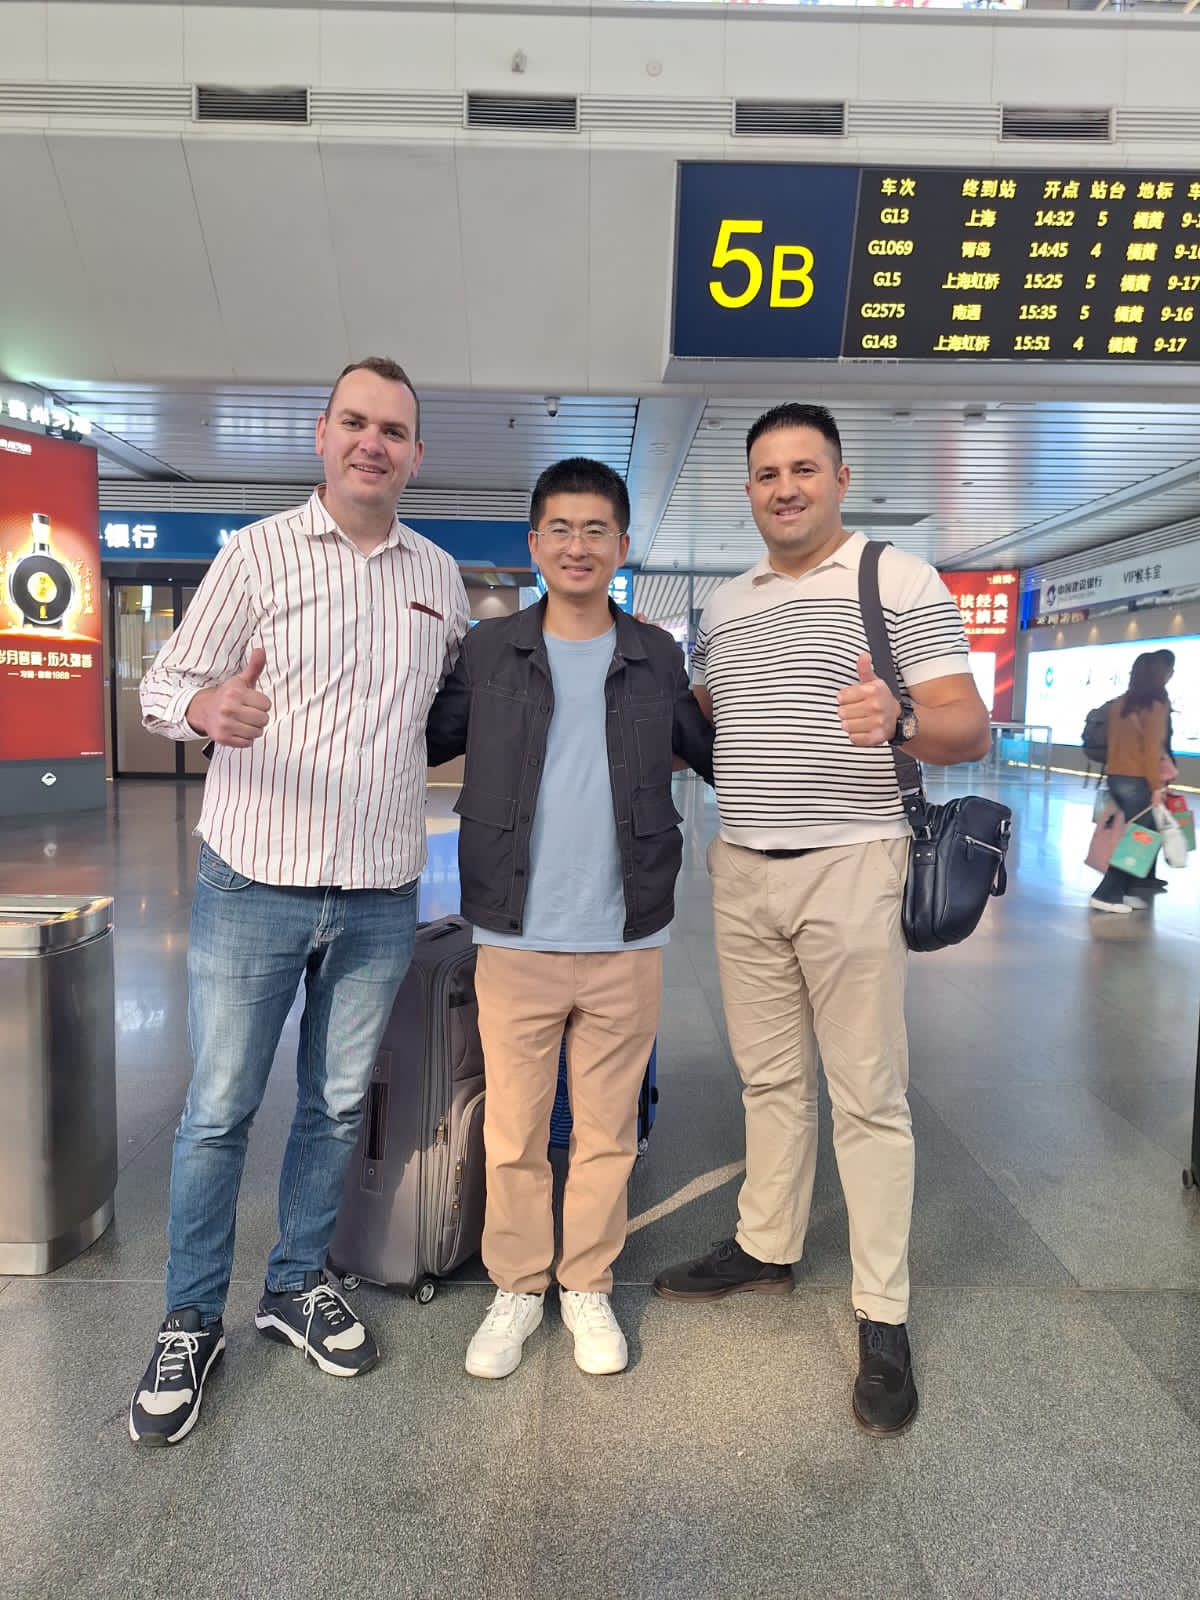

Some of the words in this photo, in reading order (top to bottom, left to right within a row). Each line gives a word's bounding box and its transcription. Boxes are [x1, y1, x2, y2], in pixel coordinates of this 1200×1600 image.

[880, 177, 916, 197] 车次
[961, 178, 1017, 199] 终到站
[1043, 180, 1081, 200] 开点
[1089, 180, 1126, 200] 站台
[1136, 181, 1174, 200] 地标
[880, 207, 910, 224] G13
[964, 208, 997, 228] 上海
[1034, 210, 1075, 227] 14:32
[1097, 210, 1109, 227] 5
[867, 239, 914, 256] G1069
[961, 241, 991, 258] 青岛
[1029, 242, 1069, 258] 14:45
[1090, 242, 1102, 258] 4
[873, 271, 902, 287] G15
[941, 271, 1001, 290] 上海虹桥
[1023, 273, 1064, 289] 15:25
[1085, 273, 1097, 290] 5
[1167, 275, 1200, 291] 9-17
[860, 303, 906, 319] G2575
[951, 303, 982, 321] 南通
[1018, 304, 1058, 320] 15:35
[1079, 304, 1091, 321] 5
[1160, 306, 1194, 322] 9-16
[861, 334, 898, 349] G143
[933, 334, 991, 352] 上海虹桥
[1013, 335, 1050, 351] 15:51
[1072, 336, 1084, 351] 4
[1153, 337, 1188, 353] 9-17
[104, 523, 157, 549] 银行
[952, 592, 1009, 609] 读经典
